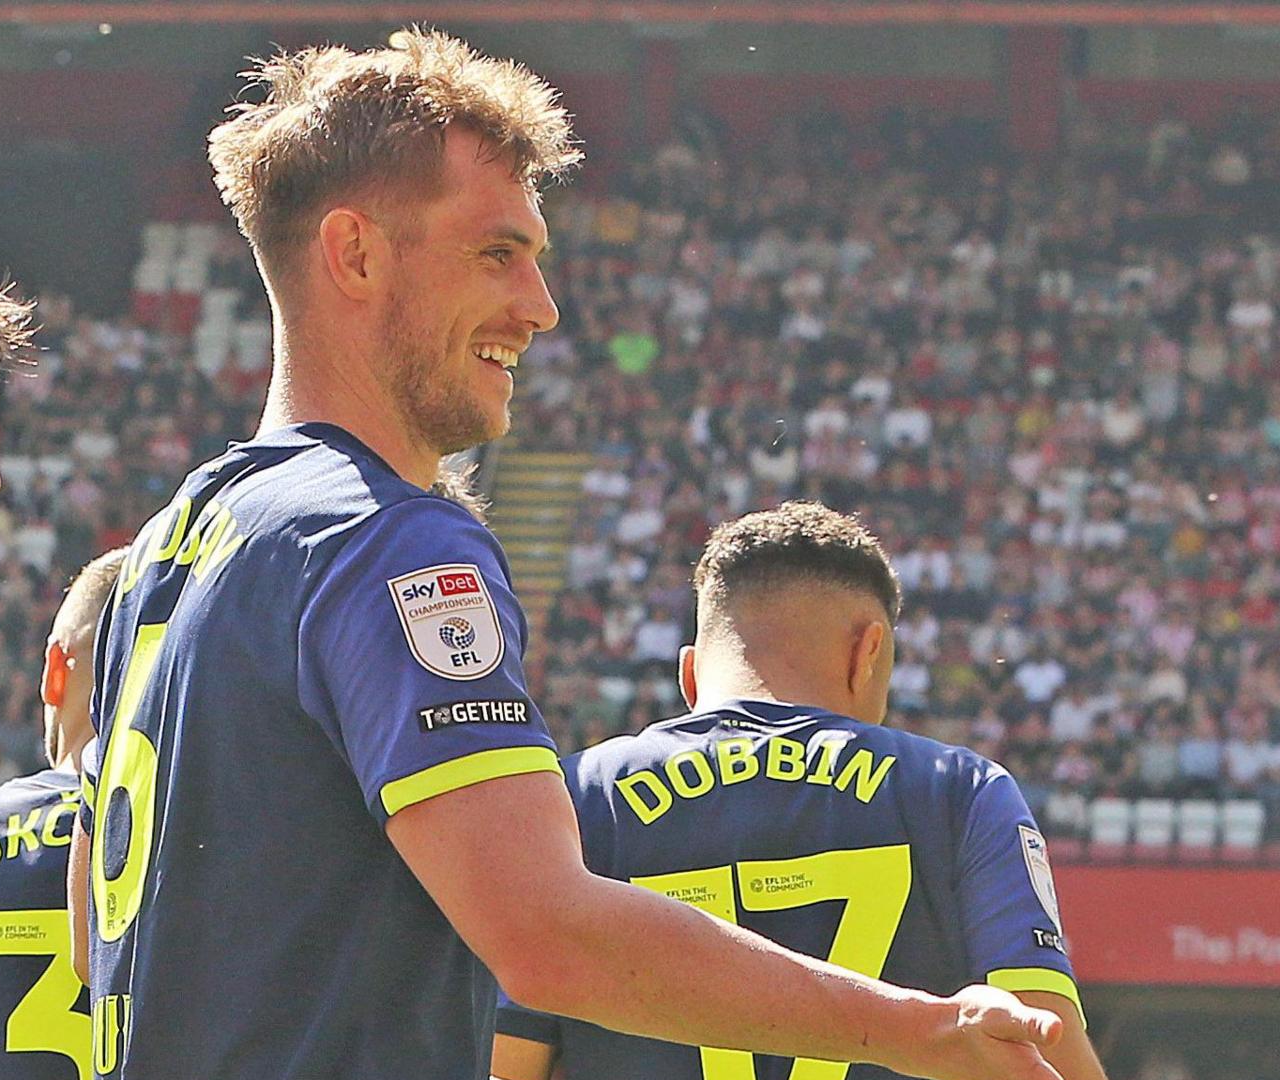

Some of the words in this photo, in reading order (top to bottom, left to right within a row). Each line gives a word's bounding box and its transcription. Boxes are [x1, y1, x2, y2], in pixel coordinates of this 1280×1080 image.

[402, 582, 436, 602] sky
[441, 575, 476, 591] bet
[409, 596, 484, 618] CHAMPIONSHIP
[451, 651, 482, 667] EFL
[615, 737, 896, 825] DOBBIN
